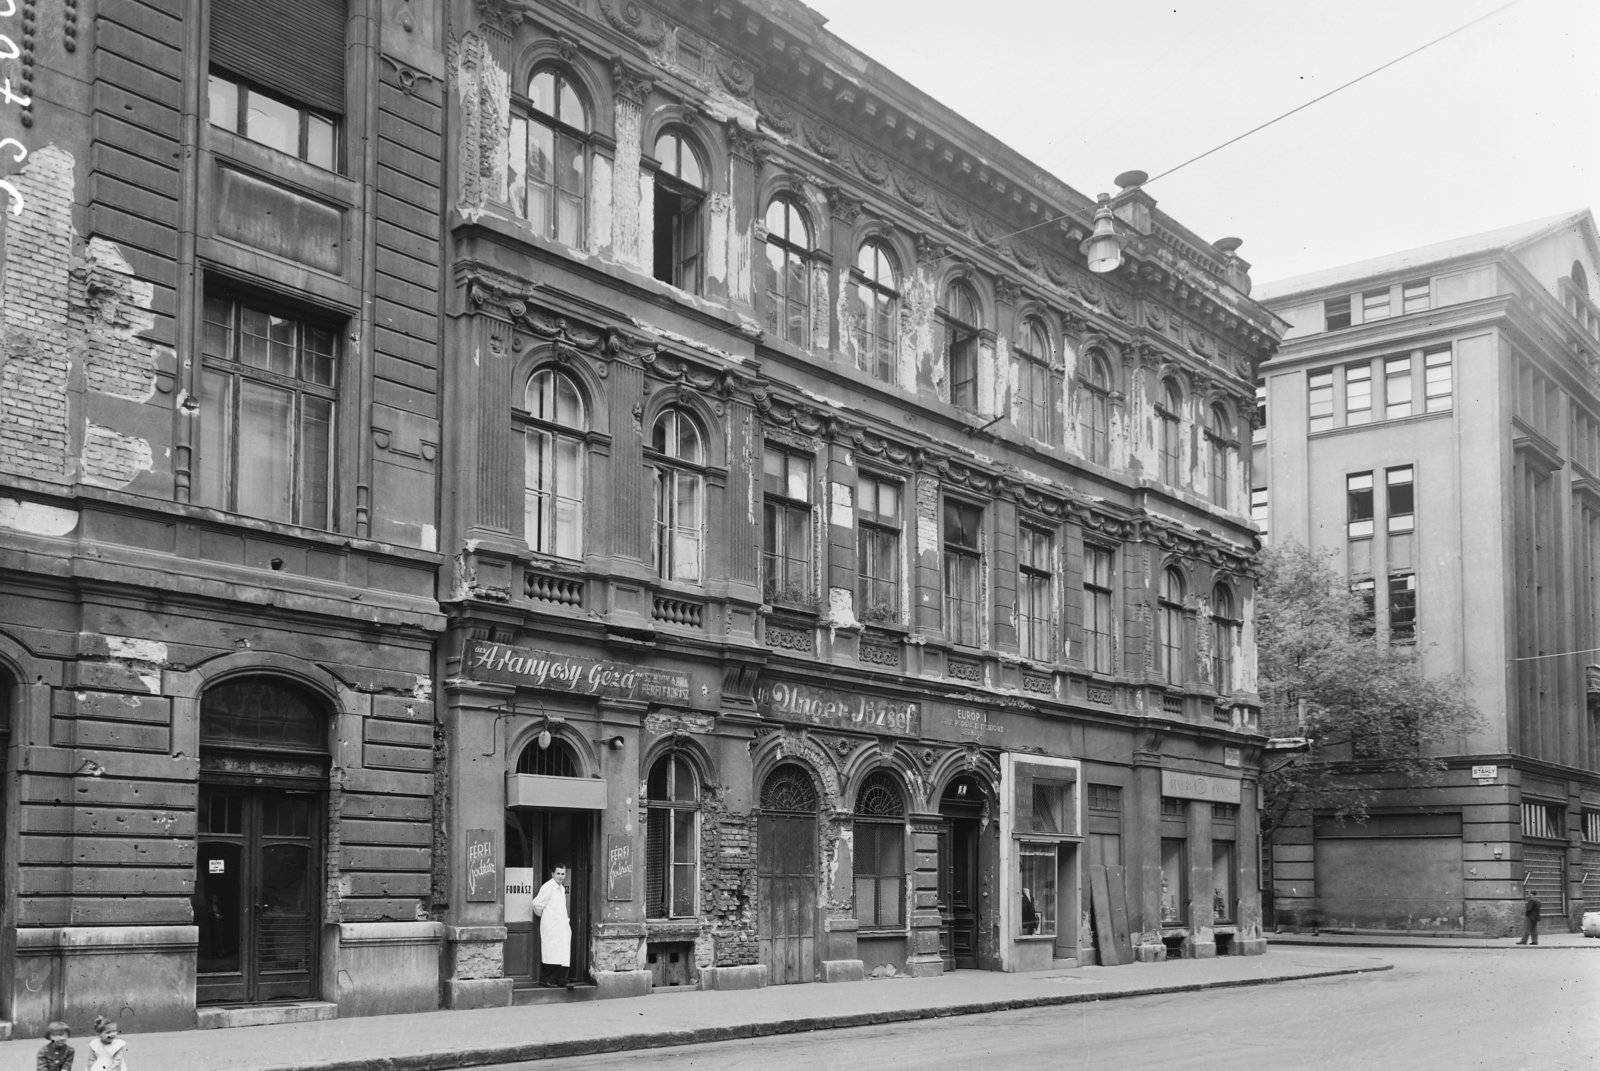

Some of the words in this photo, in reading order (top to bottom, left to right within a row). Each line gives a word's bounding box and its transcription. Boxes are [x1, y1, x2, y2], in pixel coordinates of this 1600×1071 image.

[467, 645, 582, 690] Aranyosy
[772, 683, 848, 723] Unger
[851, 698, 916, 733] József
[469, 840, 491, 861] FÉRFI
[610, 845, 629, 862] FÉRFI
[506, 882, 532, 895] FODRÁSZ
